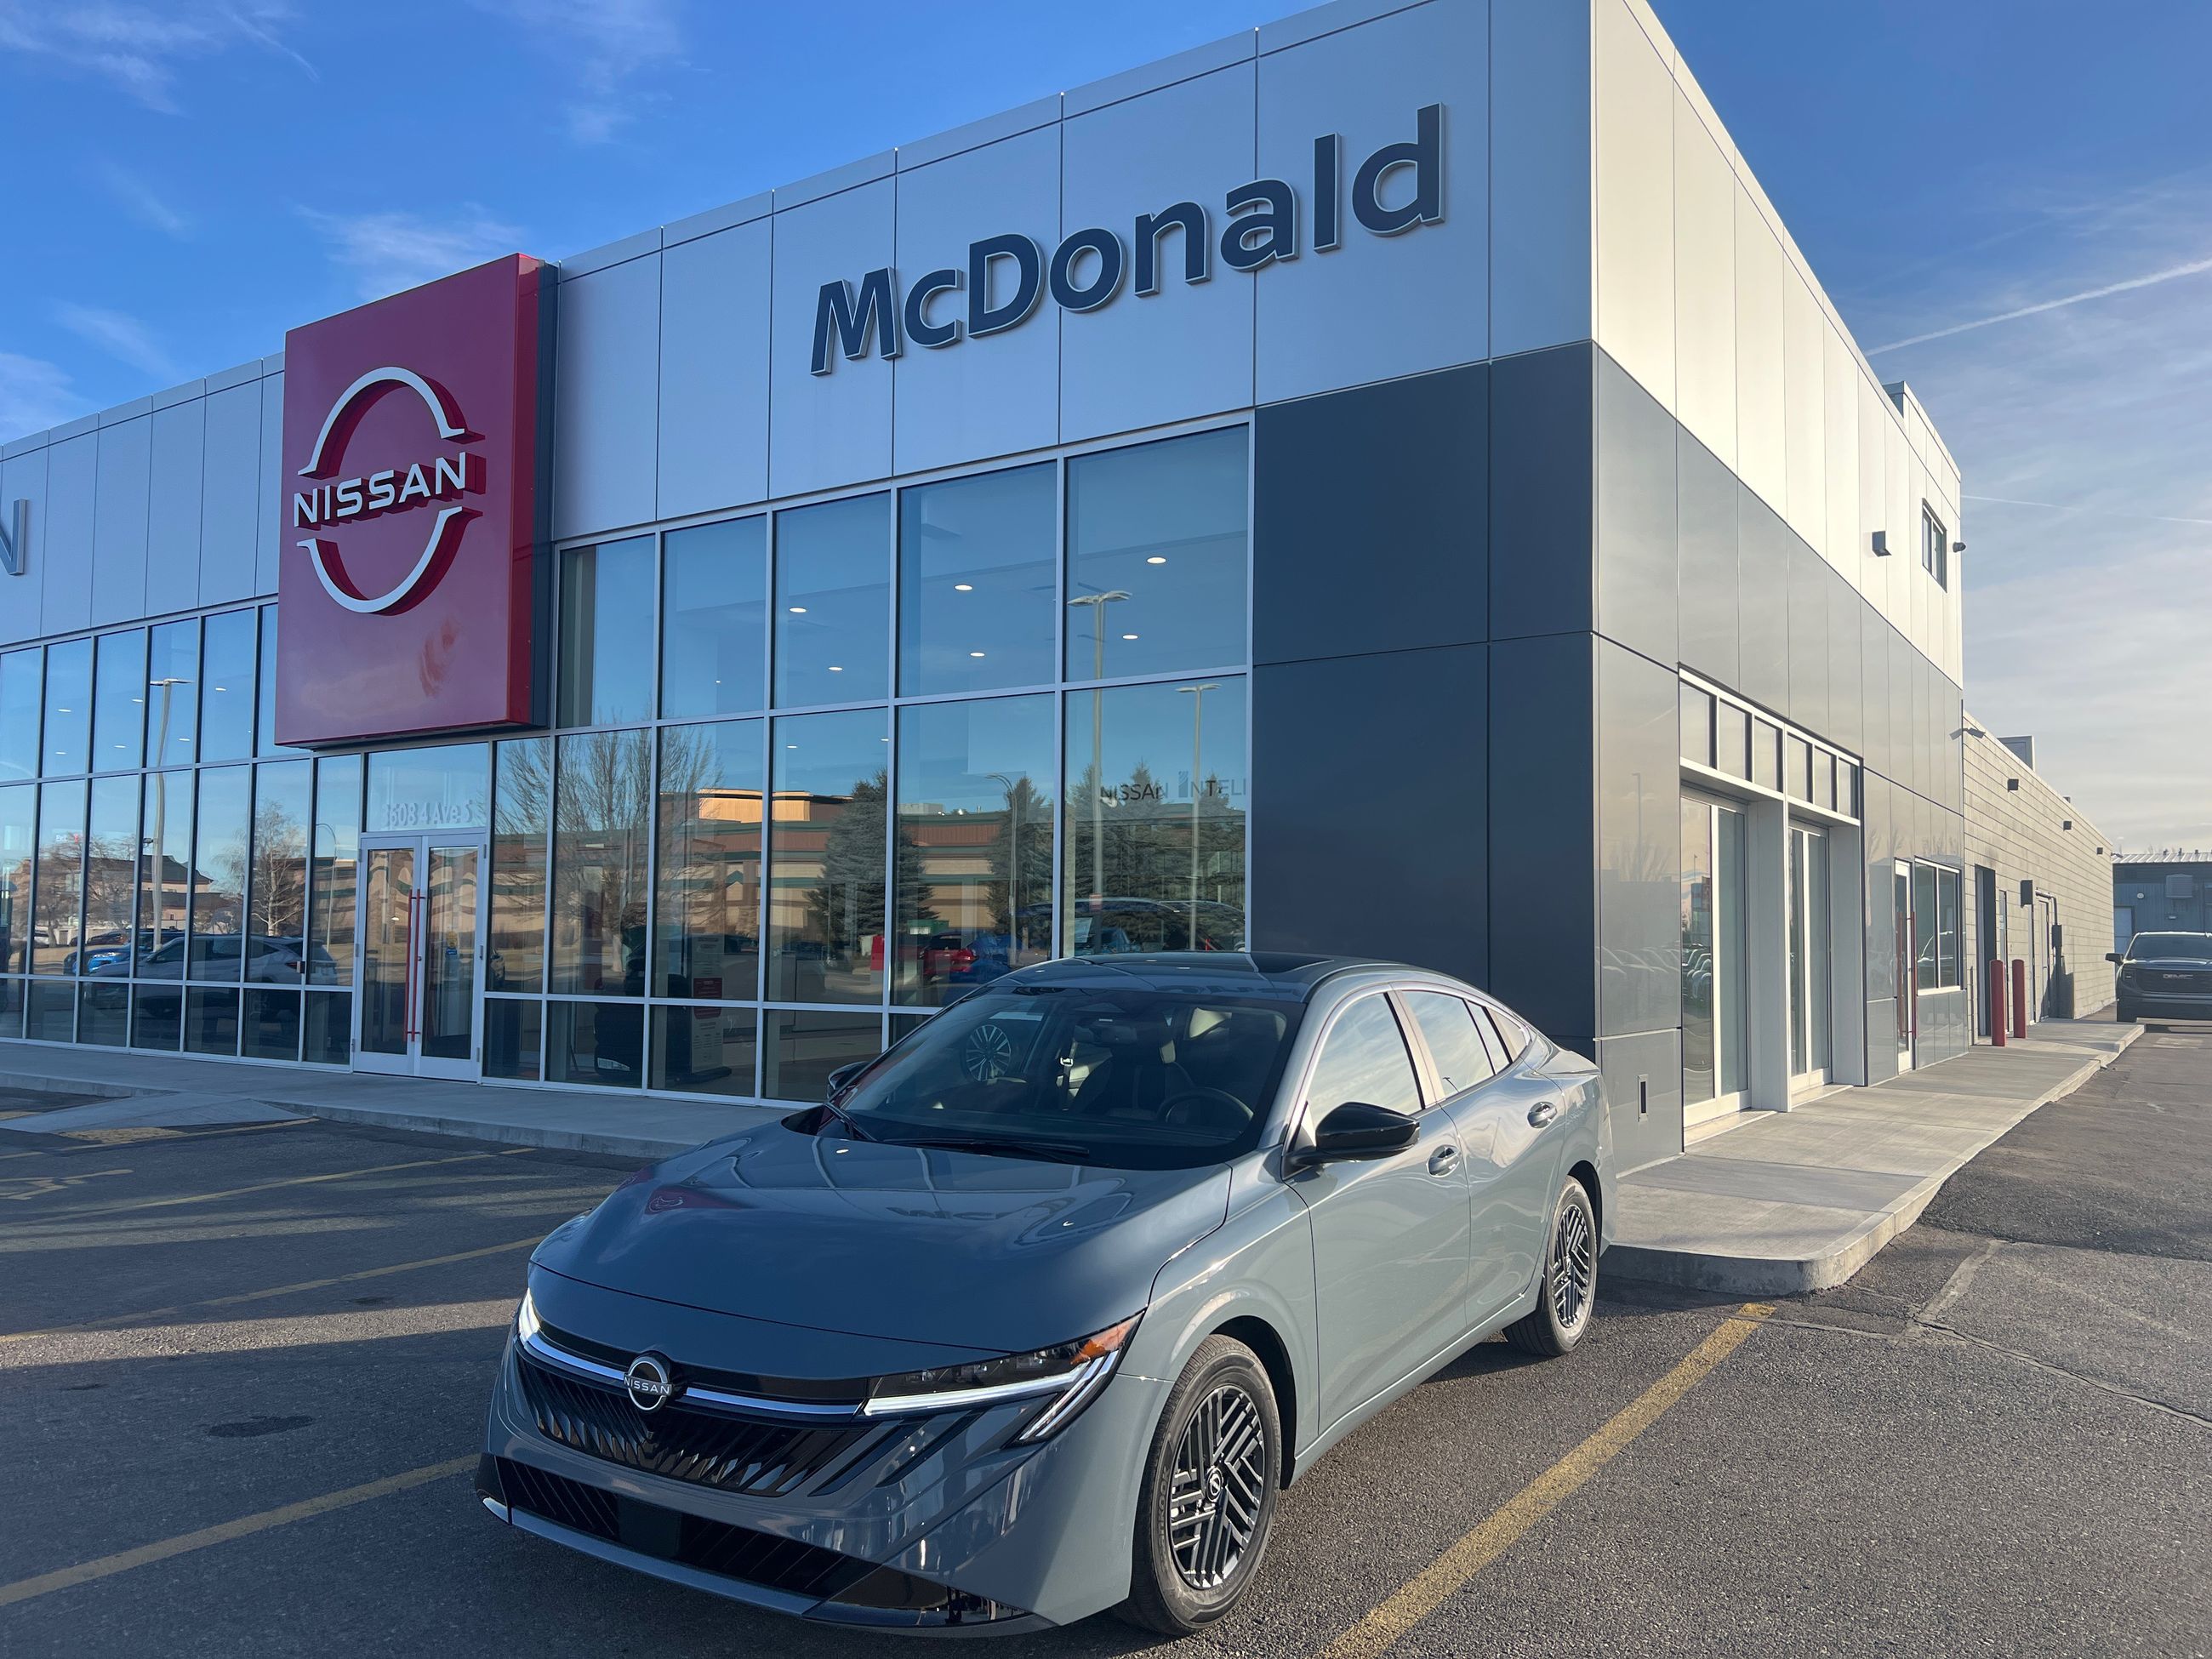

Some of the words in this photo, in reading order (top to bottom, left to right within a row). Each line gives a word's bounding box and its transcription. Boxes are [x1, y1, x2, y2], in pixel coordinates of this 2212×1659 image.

[811, 102, 1445, 376] McDonald
[294, 452, 466, 527] NISSAN
[1100, 782, 1168, 801] NISSAN
[624, 1377, 670, 1394] NISSAN
